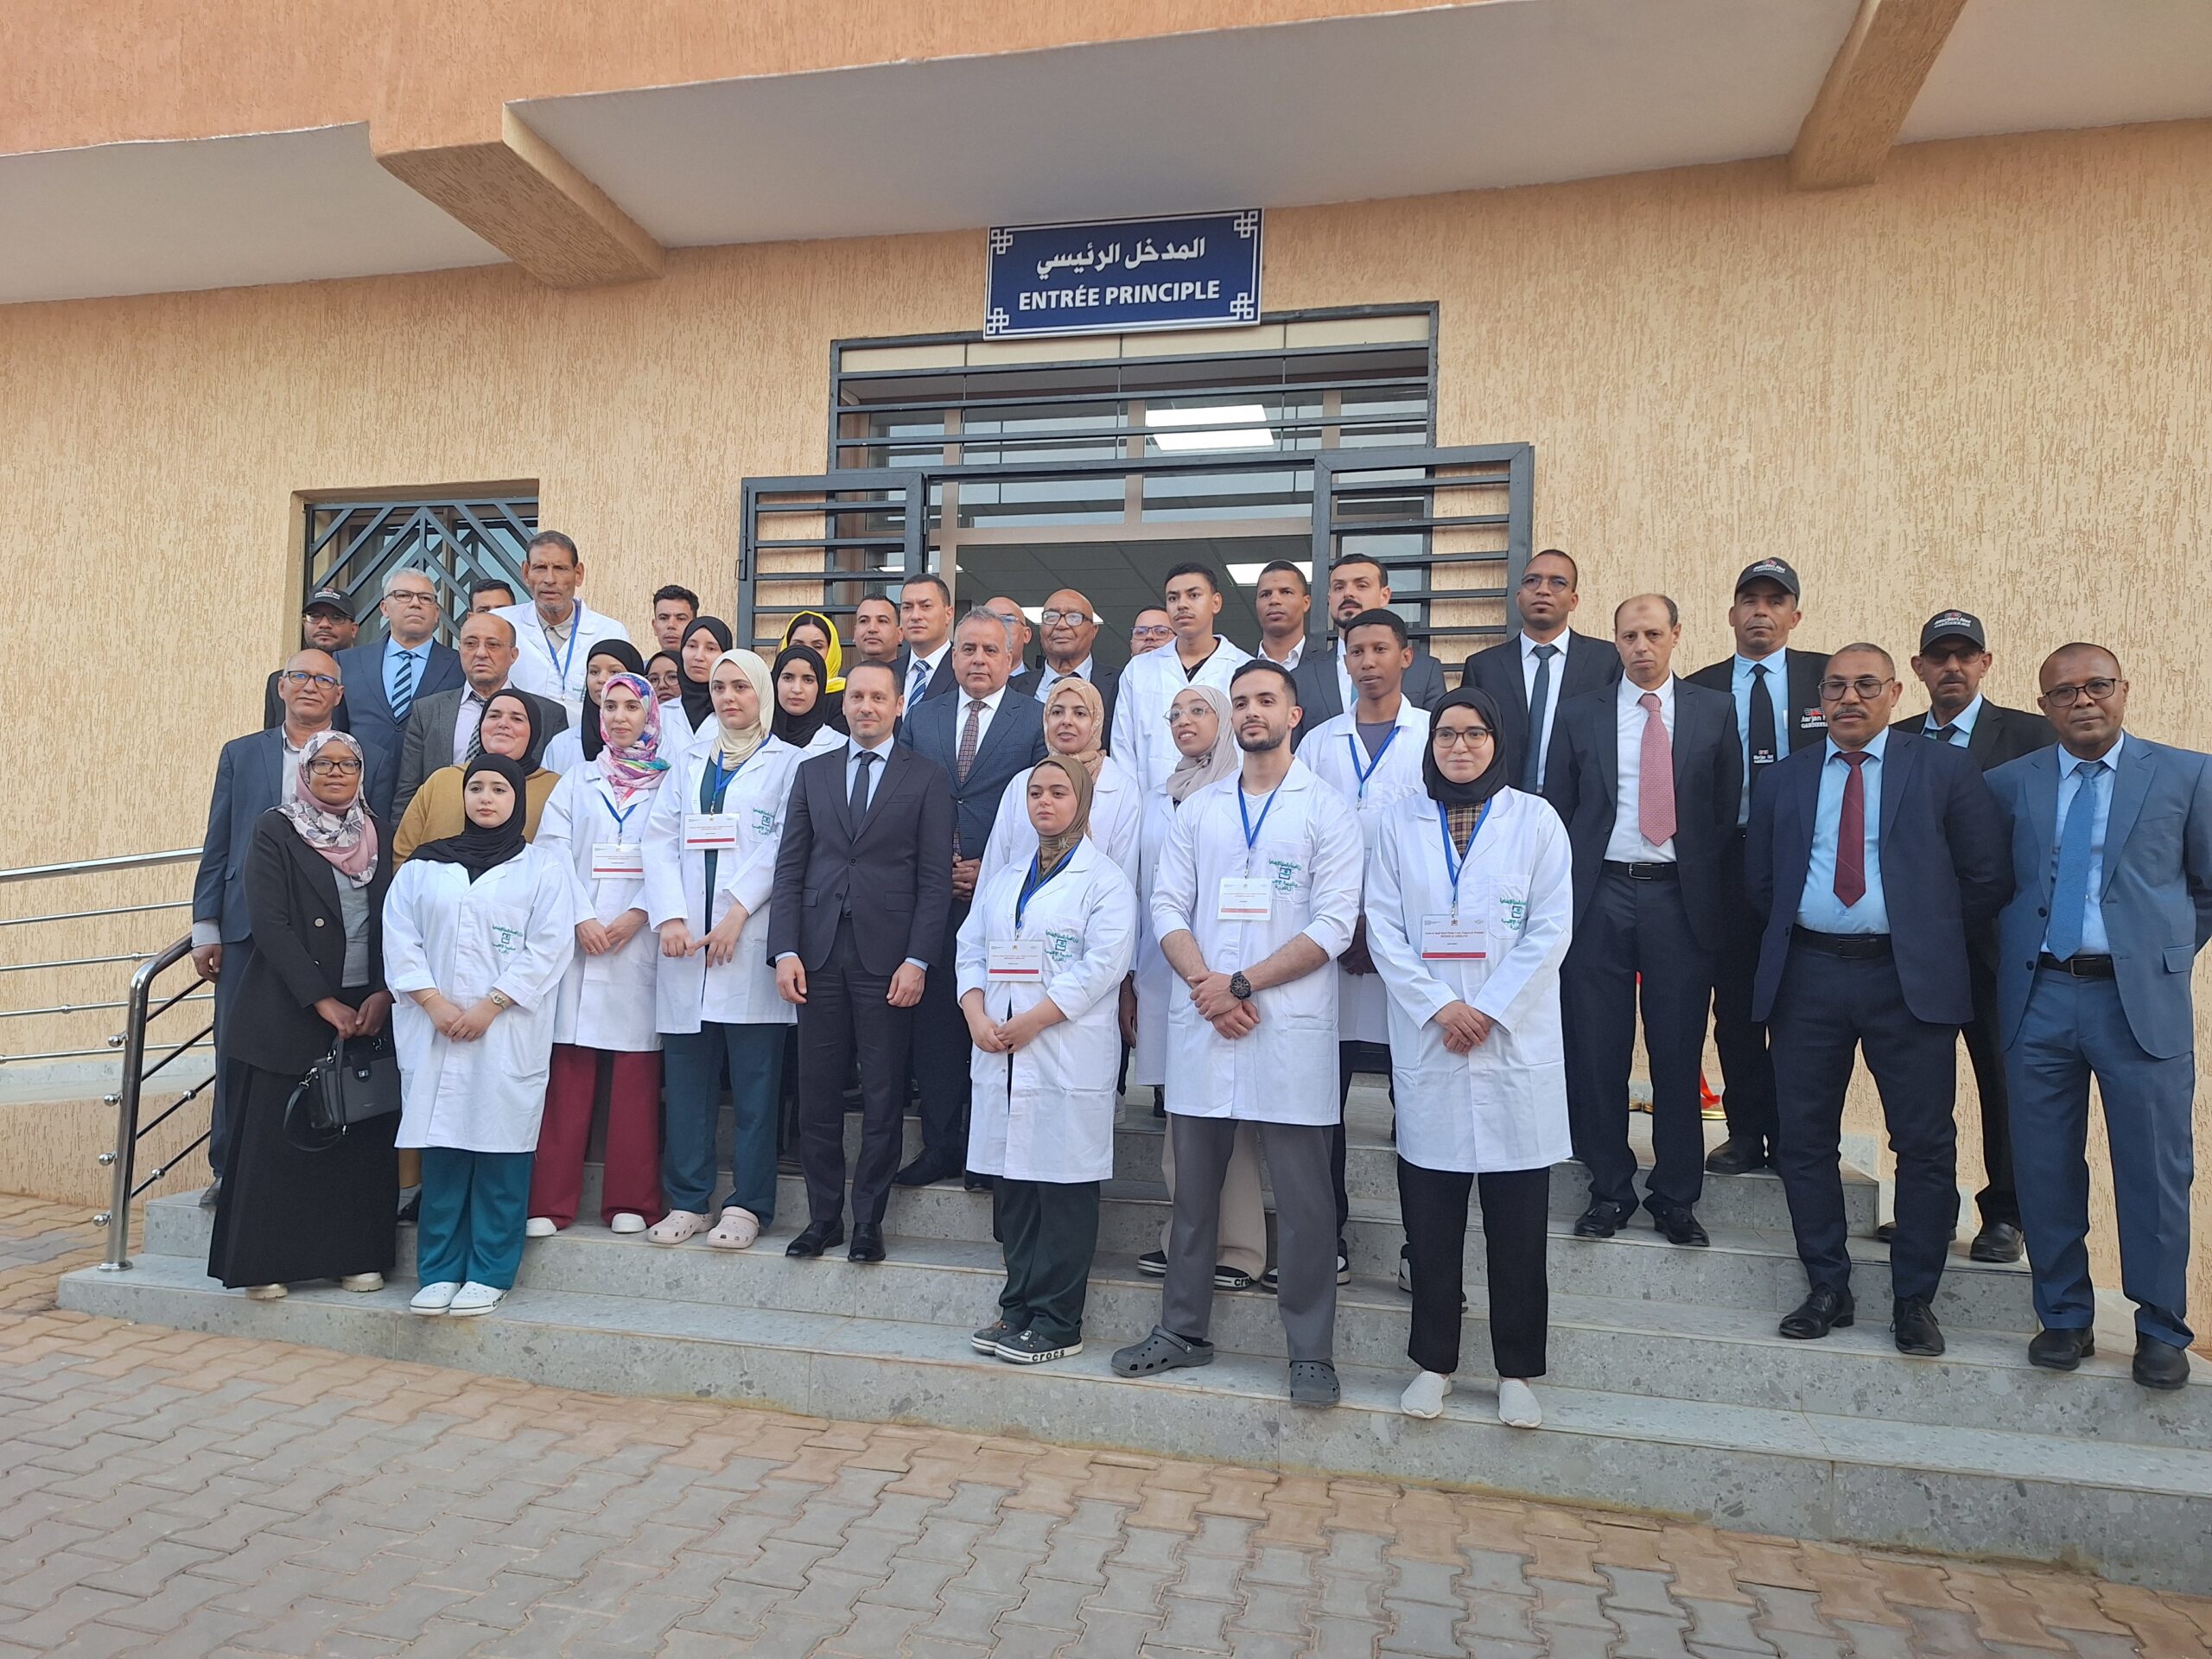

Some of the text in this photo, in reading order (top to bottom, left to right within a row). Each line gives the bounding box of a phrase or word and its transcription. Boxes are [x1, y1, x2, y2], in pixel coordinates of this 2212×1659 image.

[1037, 237, 1206, 281] المدخل الرئيسي
[1019, 280, 1221, 311] ENTRÉE PRINCIPLE
[1032, 1349, 1065, 1362] crocs
